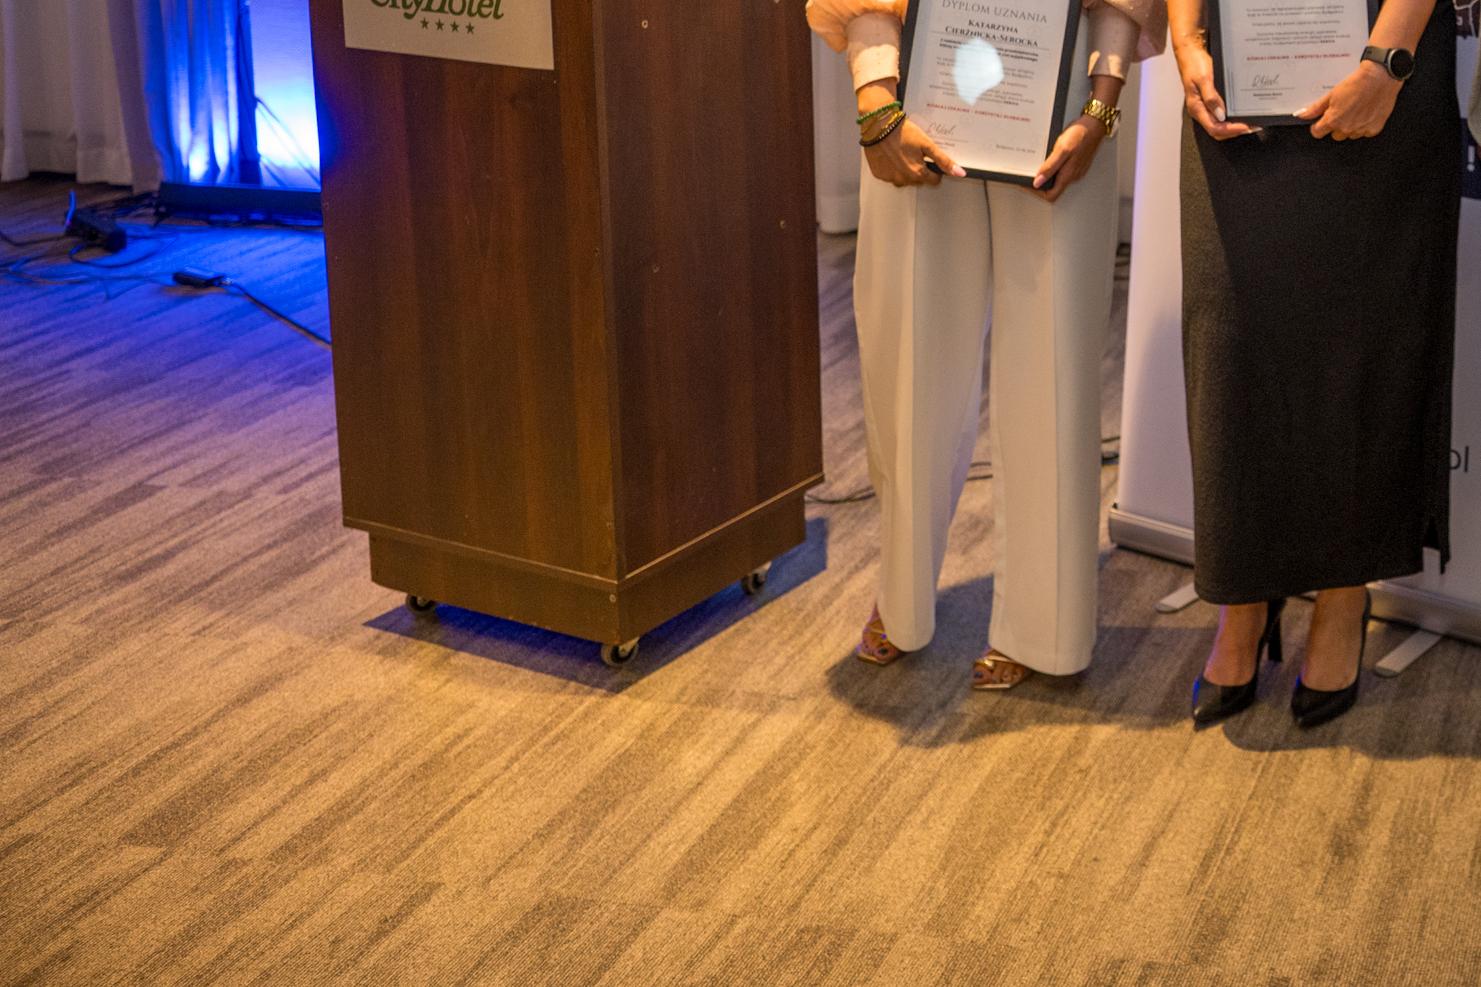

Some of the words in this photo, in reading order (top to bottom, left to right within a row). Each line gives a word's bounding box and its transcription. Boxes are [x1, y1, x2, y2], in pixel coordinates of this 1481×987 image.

[942, 0, 990, 14] DYPLOM
[994, 7, 1048, 24] UZNANIA
[968, 19, 1018, 34] KATARZYNA
